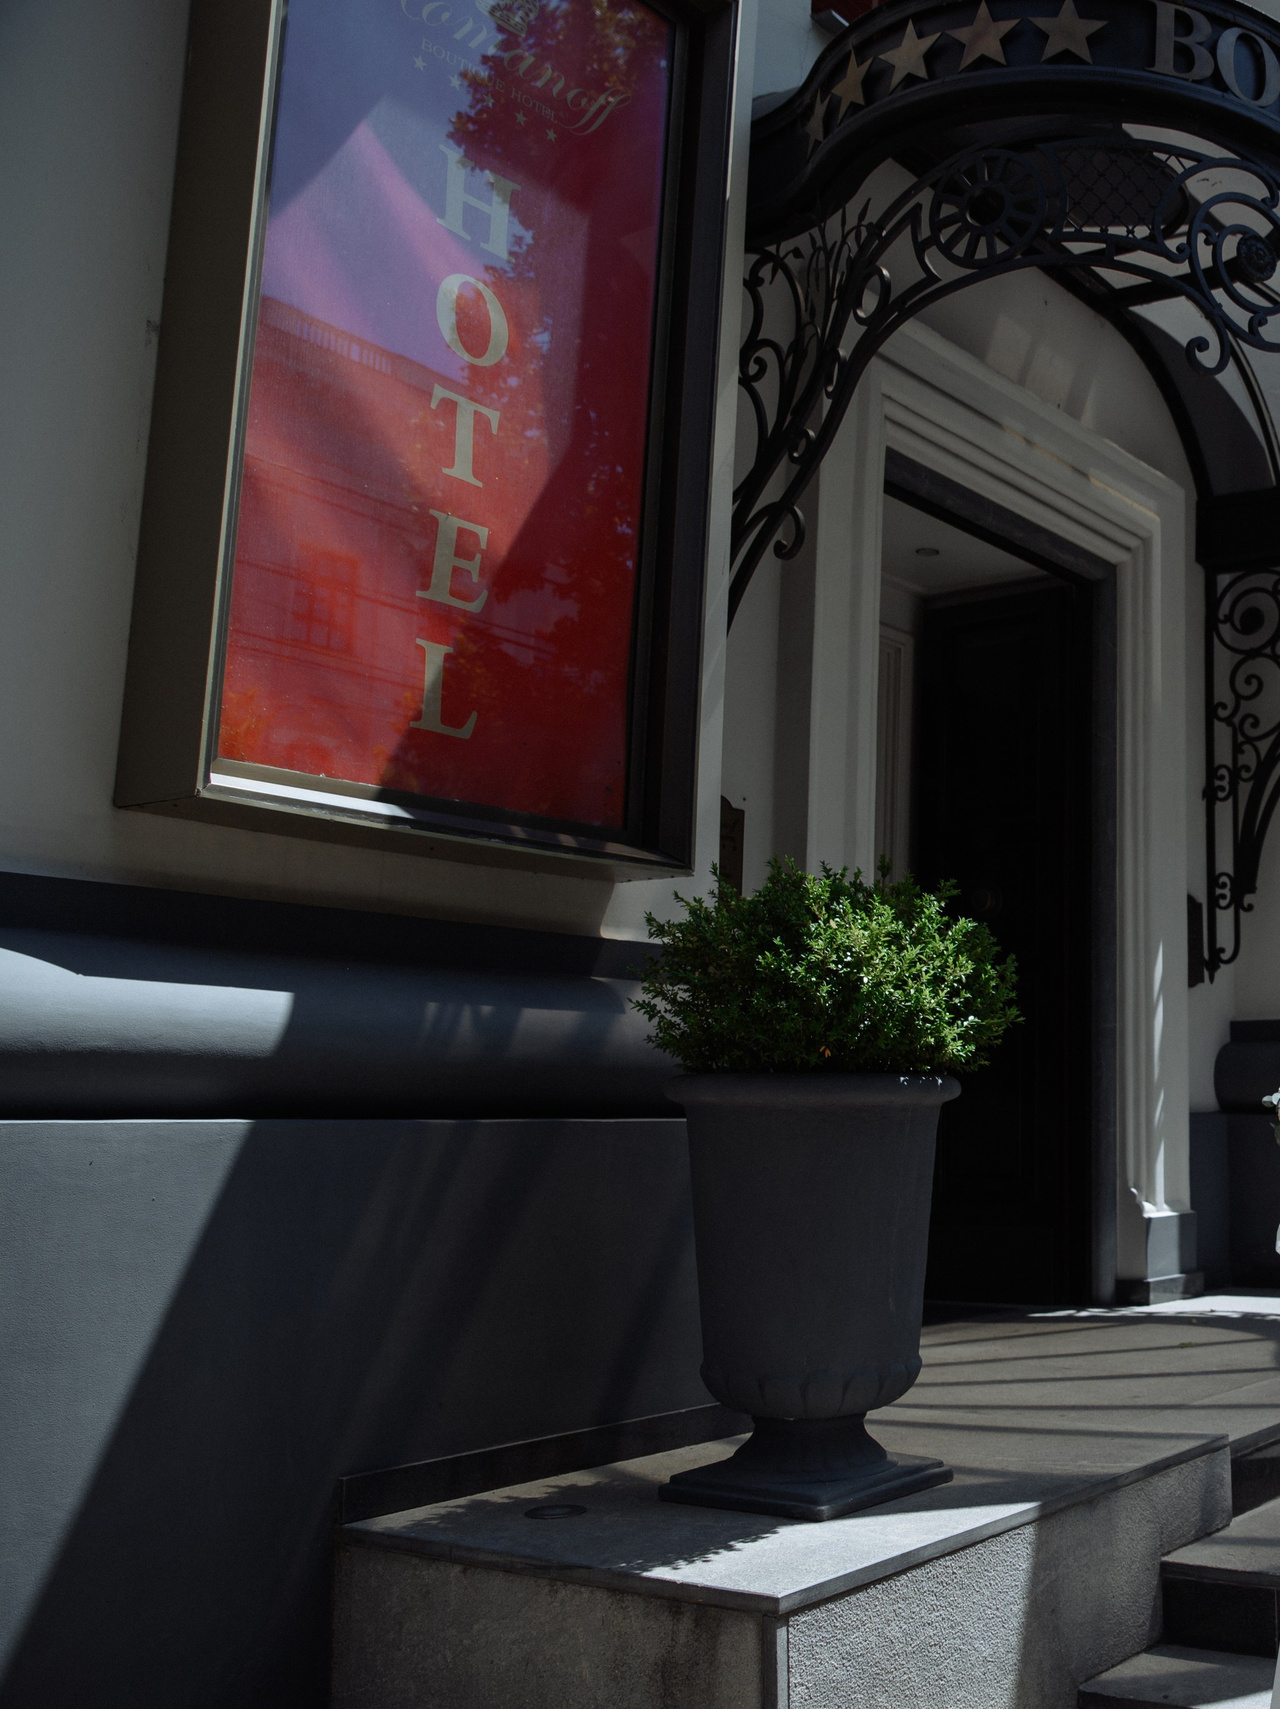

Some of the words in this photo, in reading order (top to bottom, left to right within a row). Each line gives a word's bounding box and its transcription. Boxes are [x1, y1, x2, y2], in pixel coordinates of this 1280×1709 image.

[401, 0, 632, 135] omanoff
[421, 38, 505, 93] BOUTIQUE
[511, 87, 559, 124] HOTEL
[410, 144, 522, 740] HOTEL
